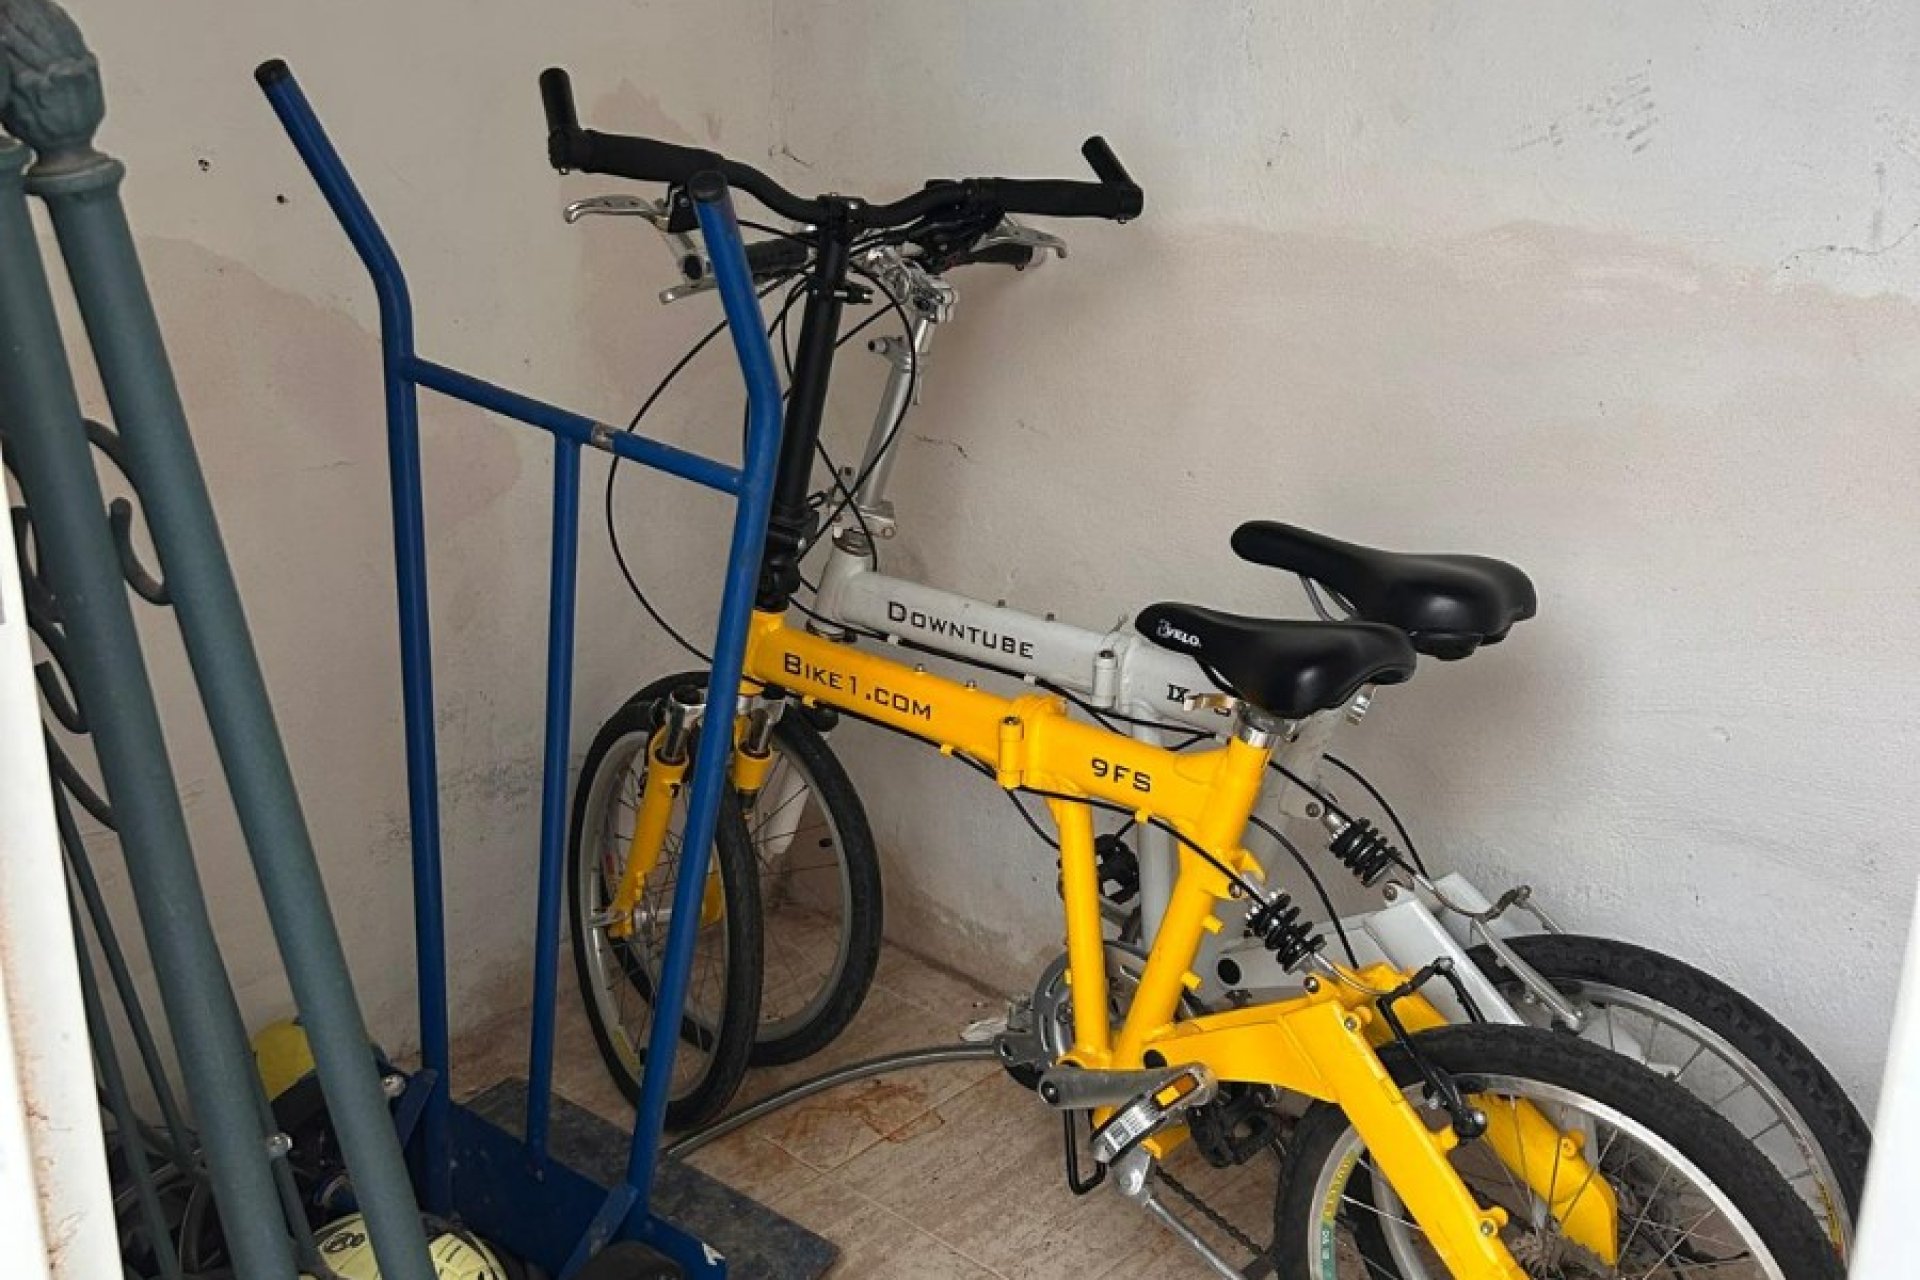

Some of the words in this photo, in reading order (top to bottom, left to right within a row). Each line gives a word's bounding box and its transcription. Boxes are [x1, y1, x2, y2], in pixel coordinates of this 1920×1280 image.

[888, 601, 1034, 659] DOWNTUBE
[1169, 628, 1200, 647] VELO
[1092, 757, 1151, 792] 9FS
